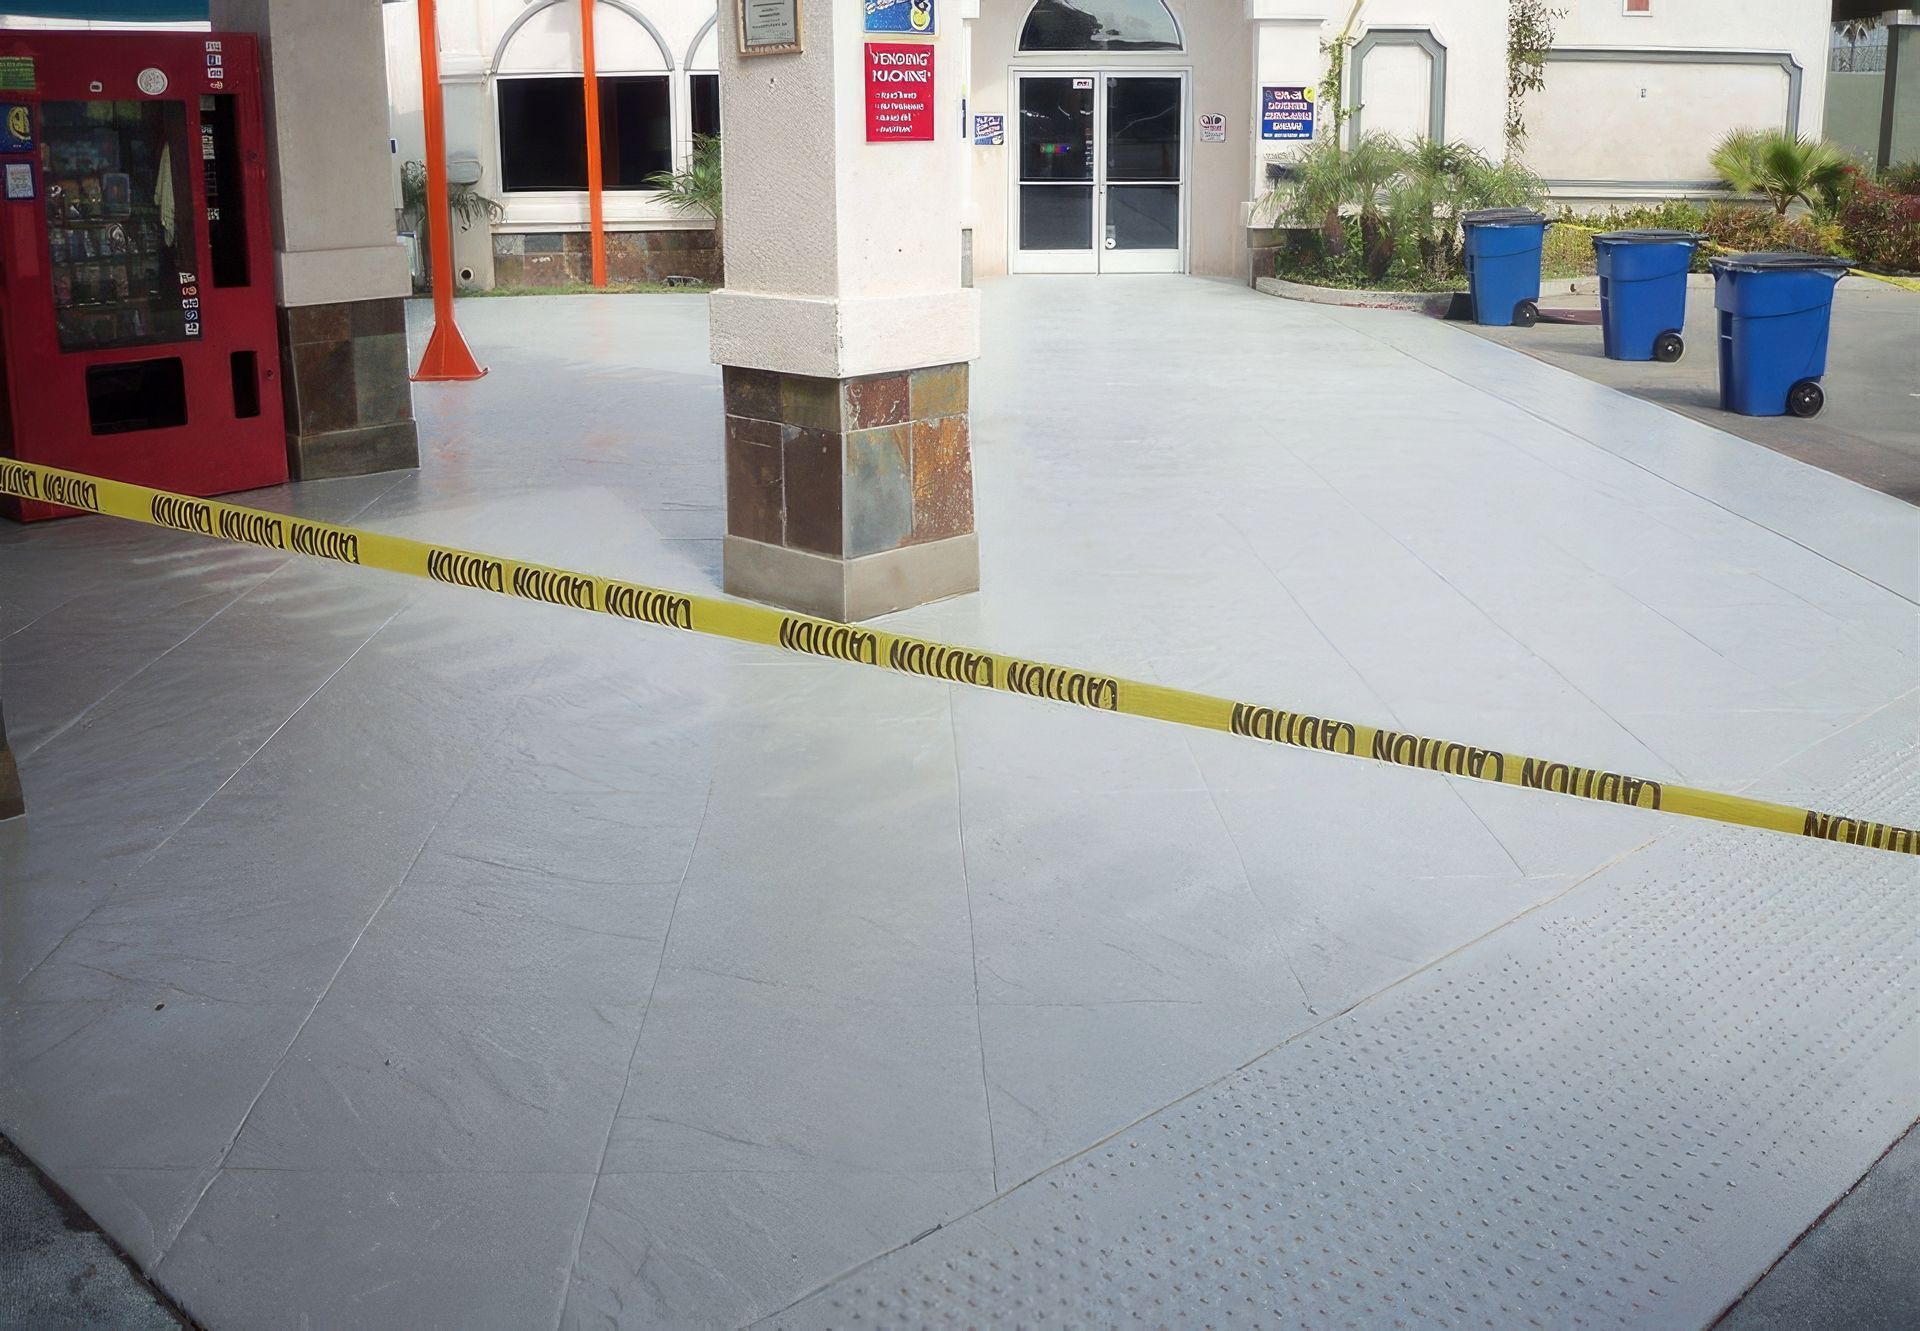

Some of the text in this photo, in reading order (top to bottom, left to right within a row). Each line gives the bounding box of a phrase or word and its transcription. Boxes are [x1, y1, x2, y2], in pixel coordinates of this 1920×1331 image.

[43, 473, 98, 511] CAUTION
[151, 495, 360, 565] CAUTION CAUTION CAUTION
[427, 549, 693, 630] CAUTION CAUTION CAUTION
[779, 617, 1118, 711] CAUTION CAUTION CAUTION
[1231, 702, 1662, 810] CAUTION CAUTION CAUTION
